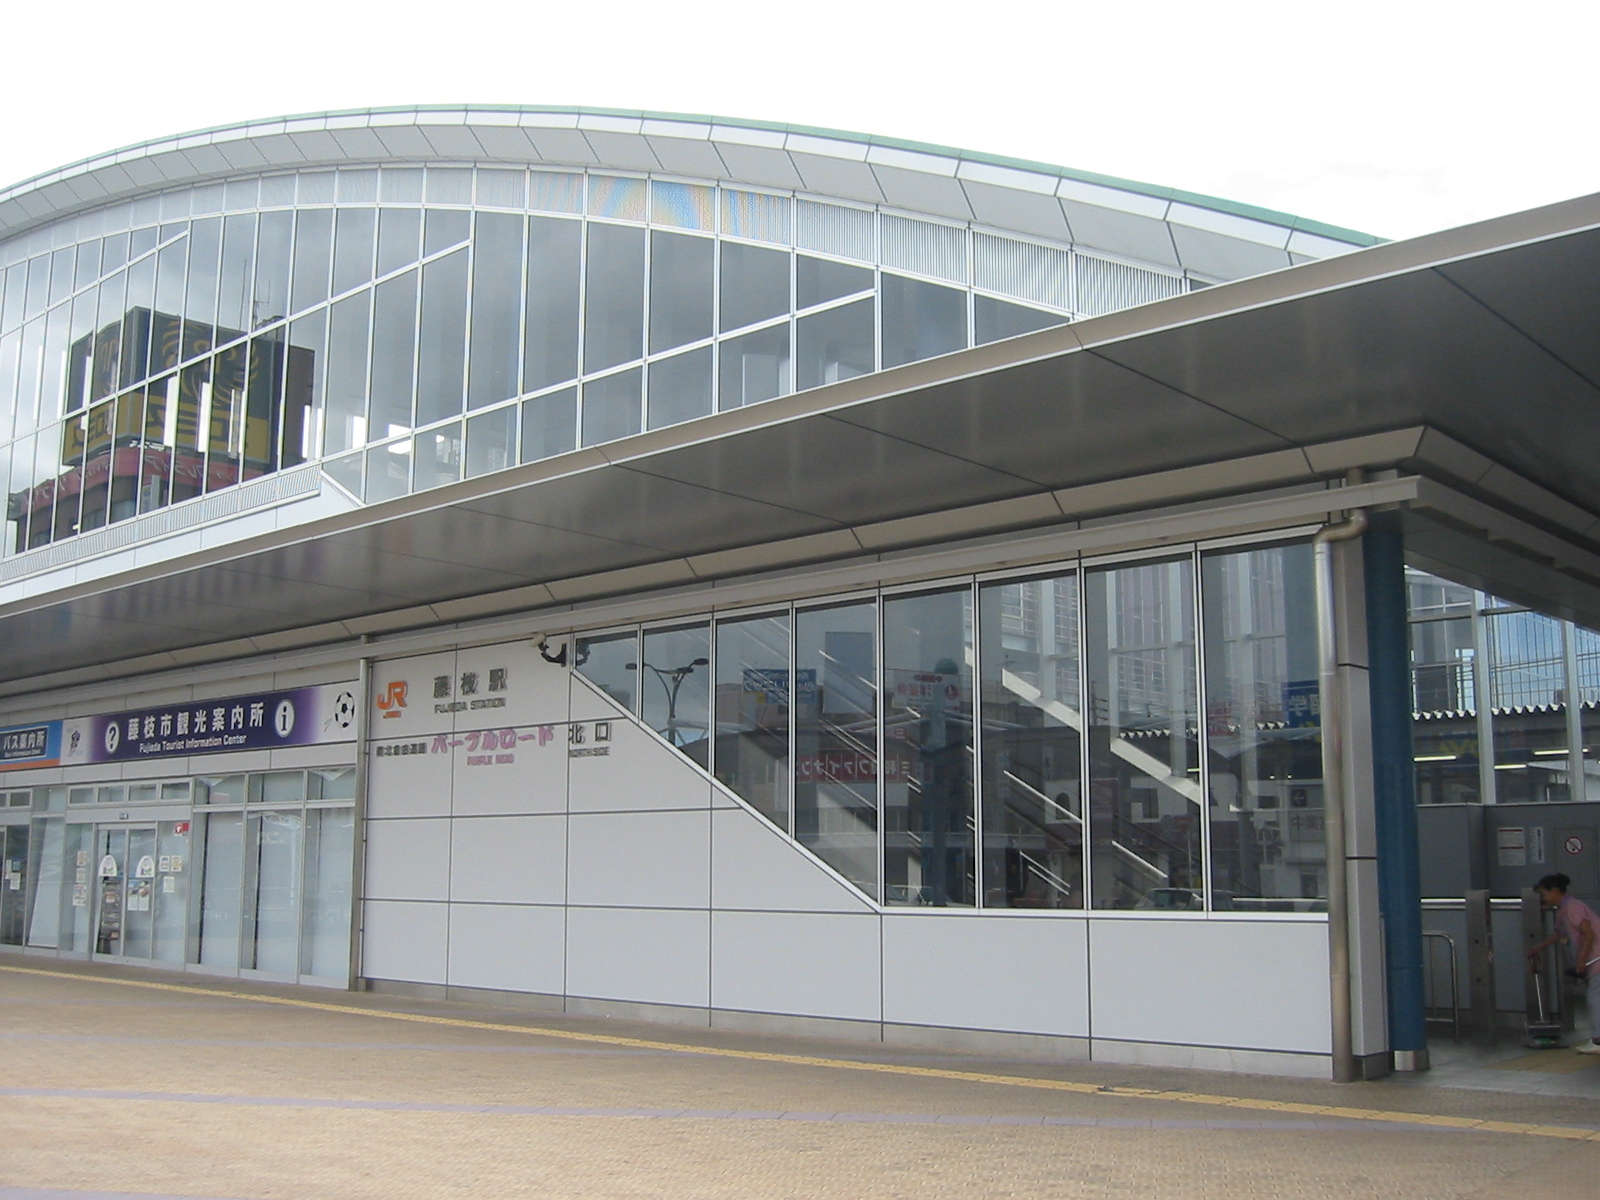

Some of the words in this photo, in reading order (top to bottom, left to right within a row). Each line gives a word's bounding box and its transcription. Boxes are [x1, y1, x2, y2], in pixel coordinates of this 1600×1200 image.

[377, 681, 408, 710] JR
[433, 668, 507, 698] 藤枝駅
[127, 703, 264, 741] 藤枝市観光案内所
[569, 722, 611, 744] 北口
[162, 740, 185, 752] Tourist
[185, 737, 222, 750] Information
[223, 734, 247, 746] Center
